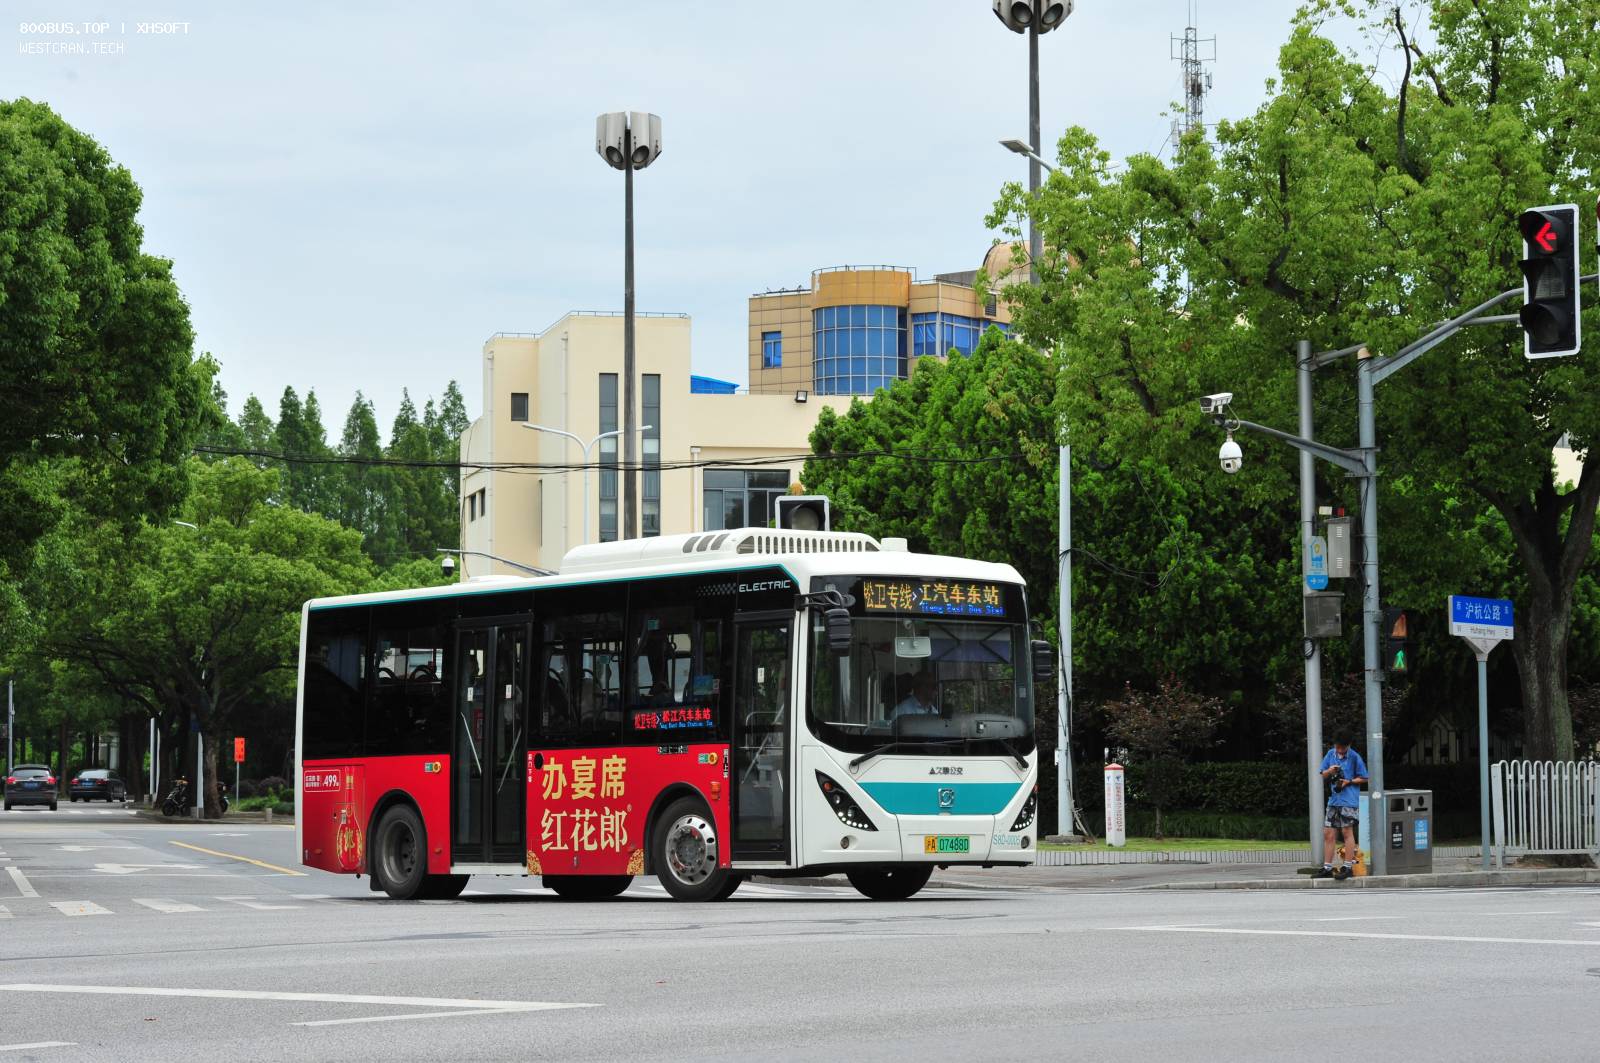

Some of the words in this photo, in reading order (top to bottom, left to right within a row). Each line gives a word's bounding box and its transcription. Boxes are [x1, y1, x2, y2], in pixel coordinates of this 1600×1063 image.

[738, 580, 791, 593] ELECTRIC
[1465, 601, 1500, 620] 沪杭公路
[662, 707, 711, 723] 松江汽车东站
[542, 754, 627, 801] 办宴席
[541, 806, 628, 853] 红花郎
